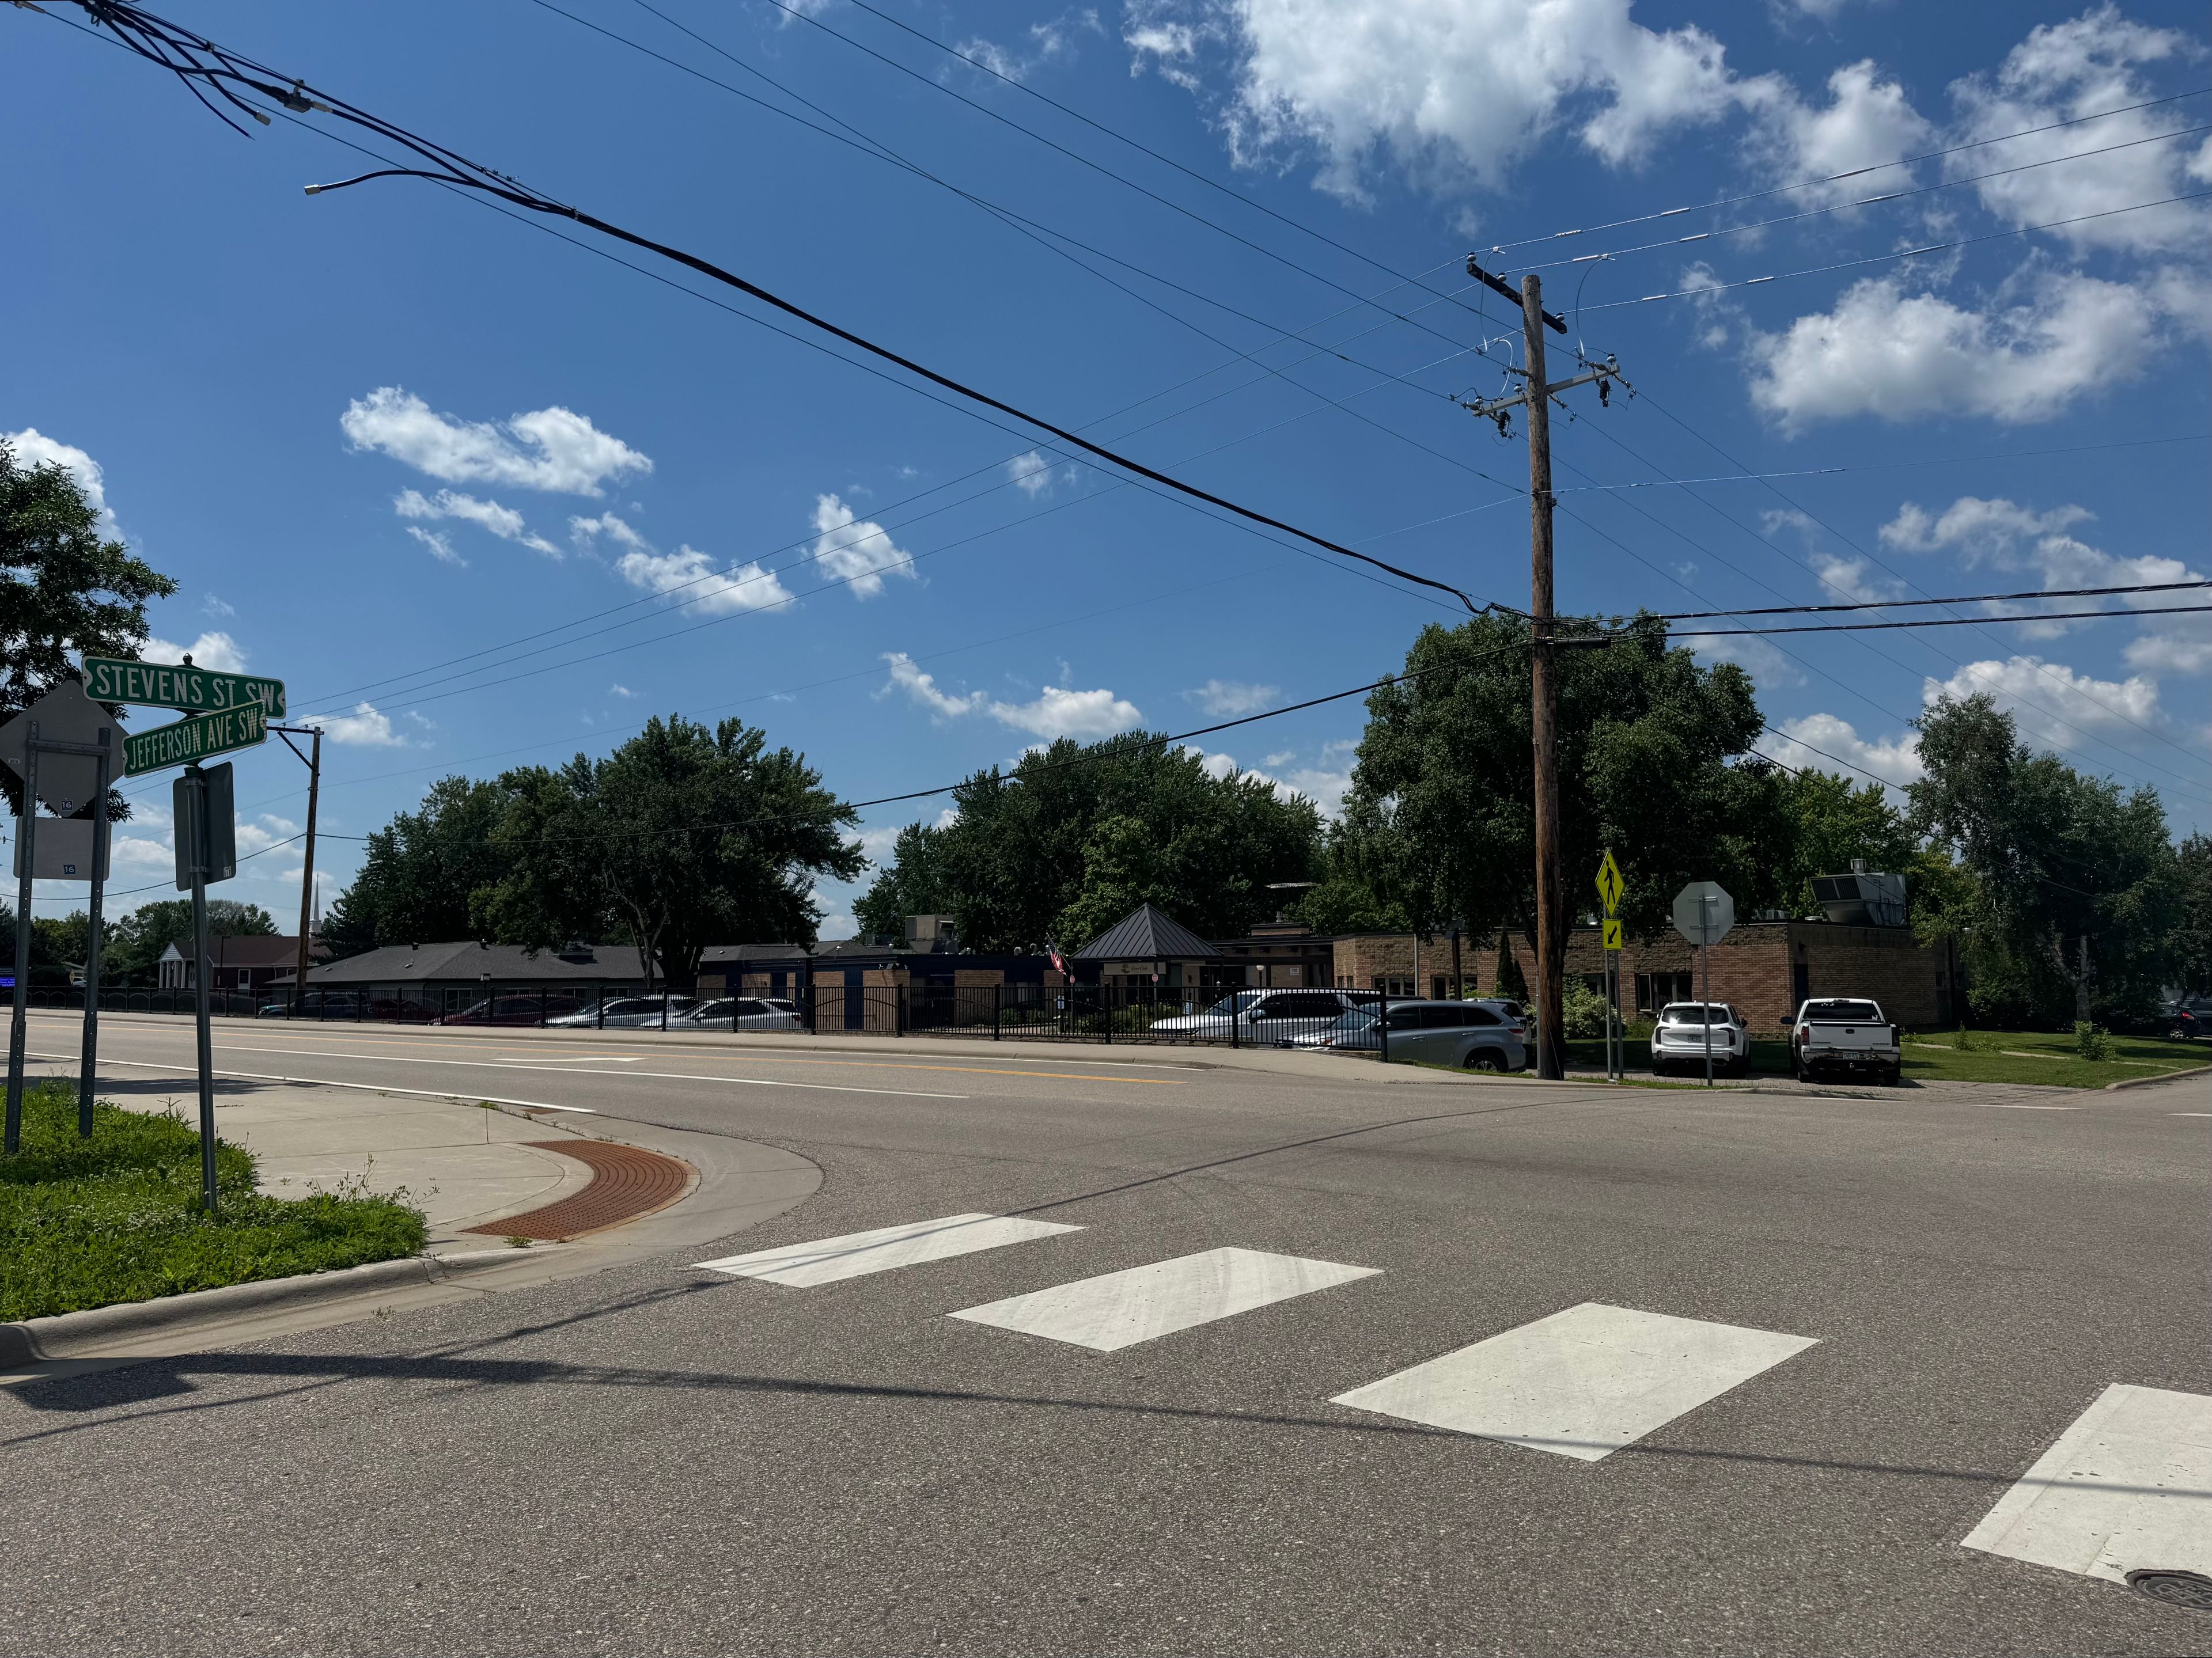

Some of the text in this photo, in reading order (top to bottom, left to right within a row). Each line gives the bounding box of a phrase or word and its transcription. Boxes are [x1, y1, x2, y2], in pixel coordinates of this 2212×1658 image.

[97, 665, 274, 712] STEVENS ST SW
[130, 708, 257, 770] JEFFERSON AVE SW
